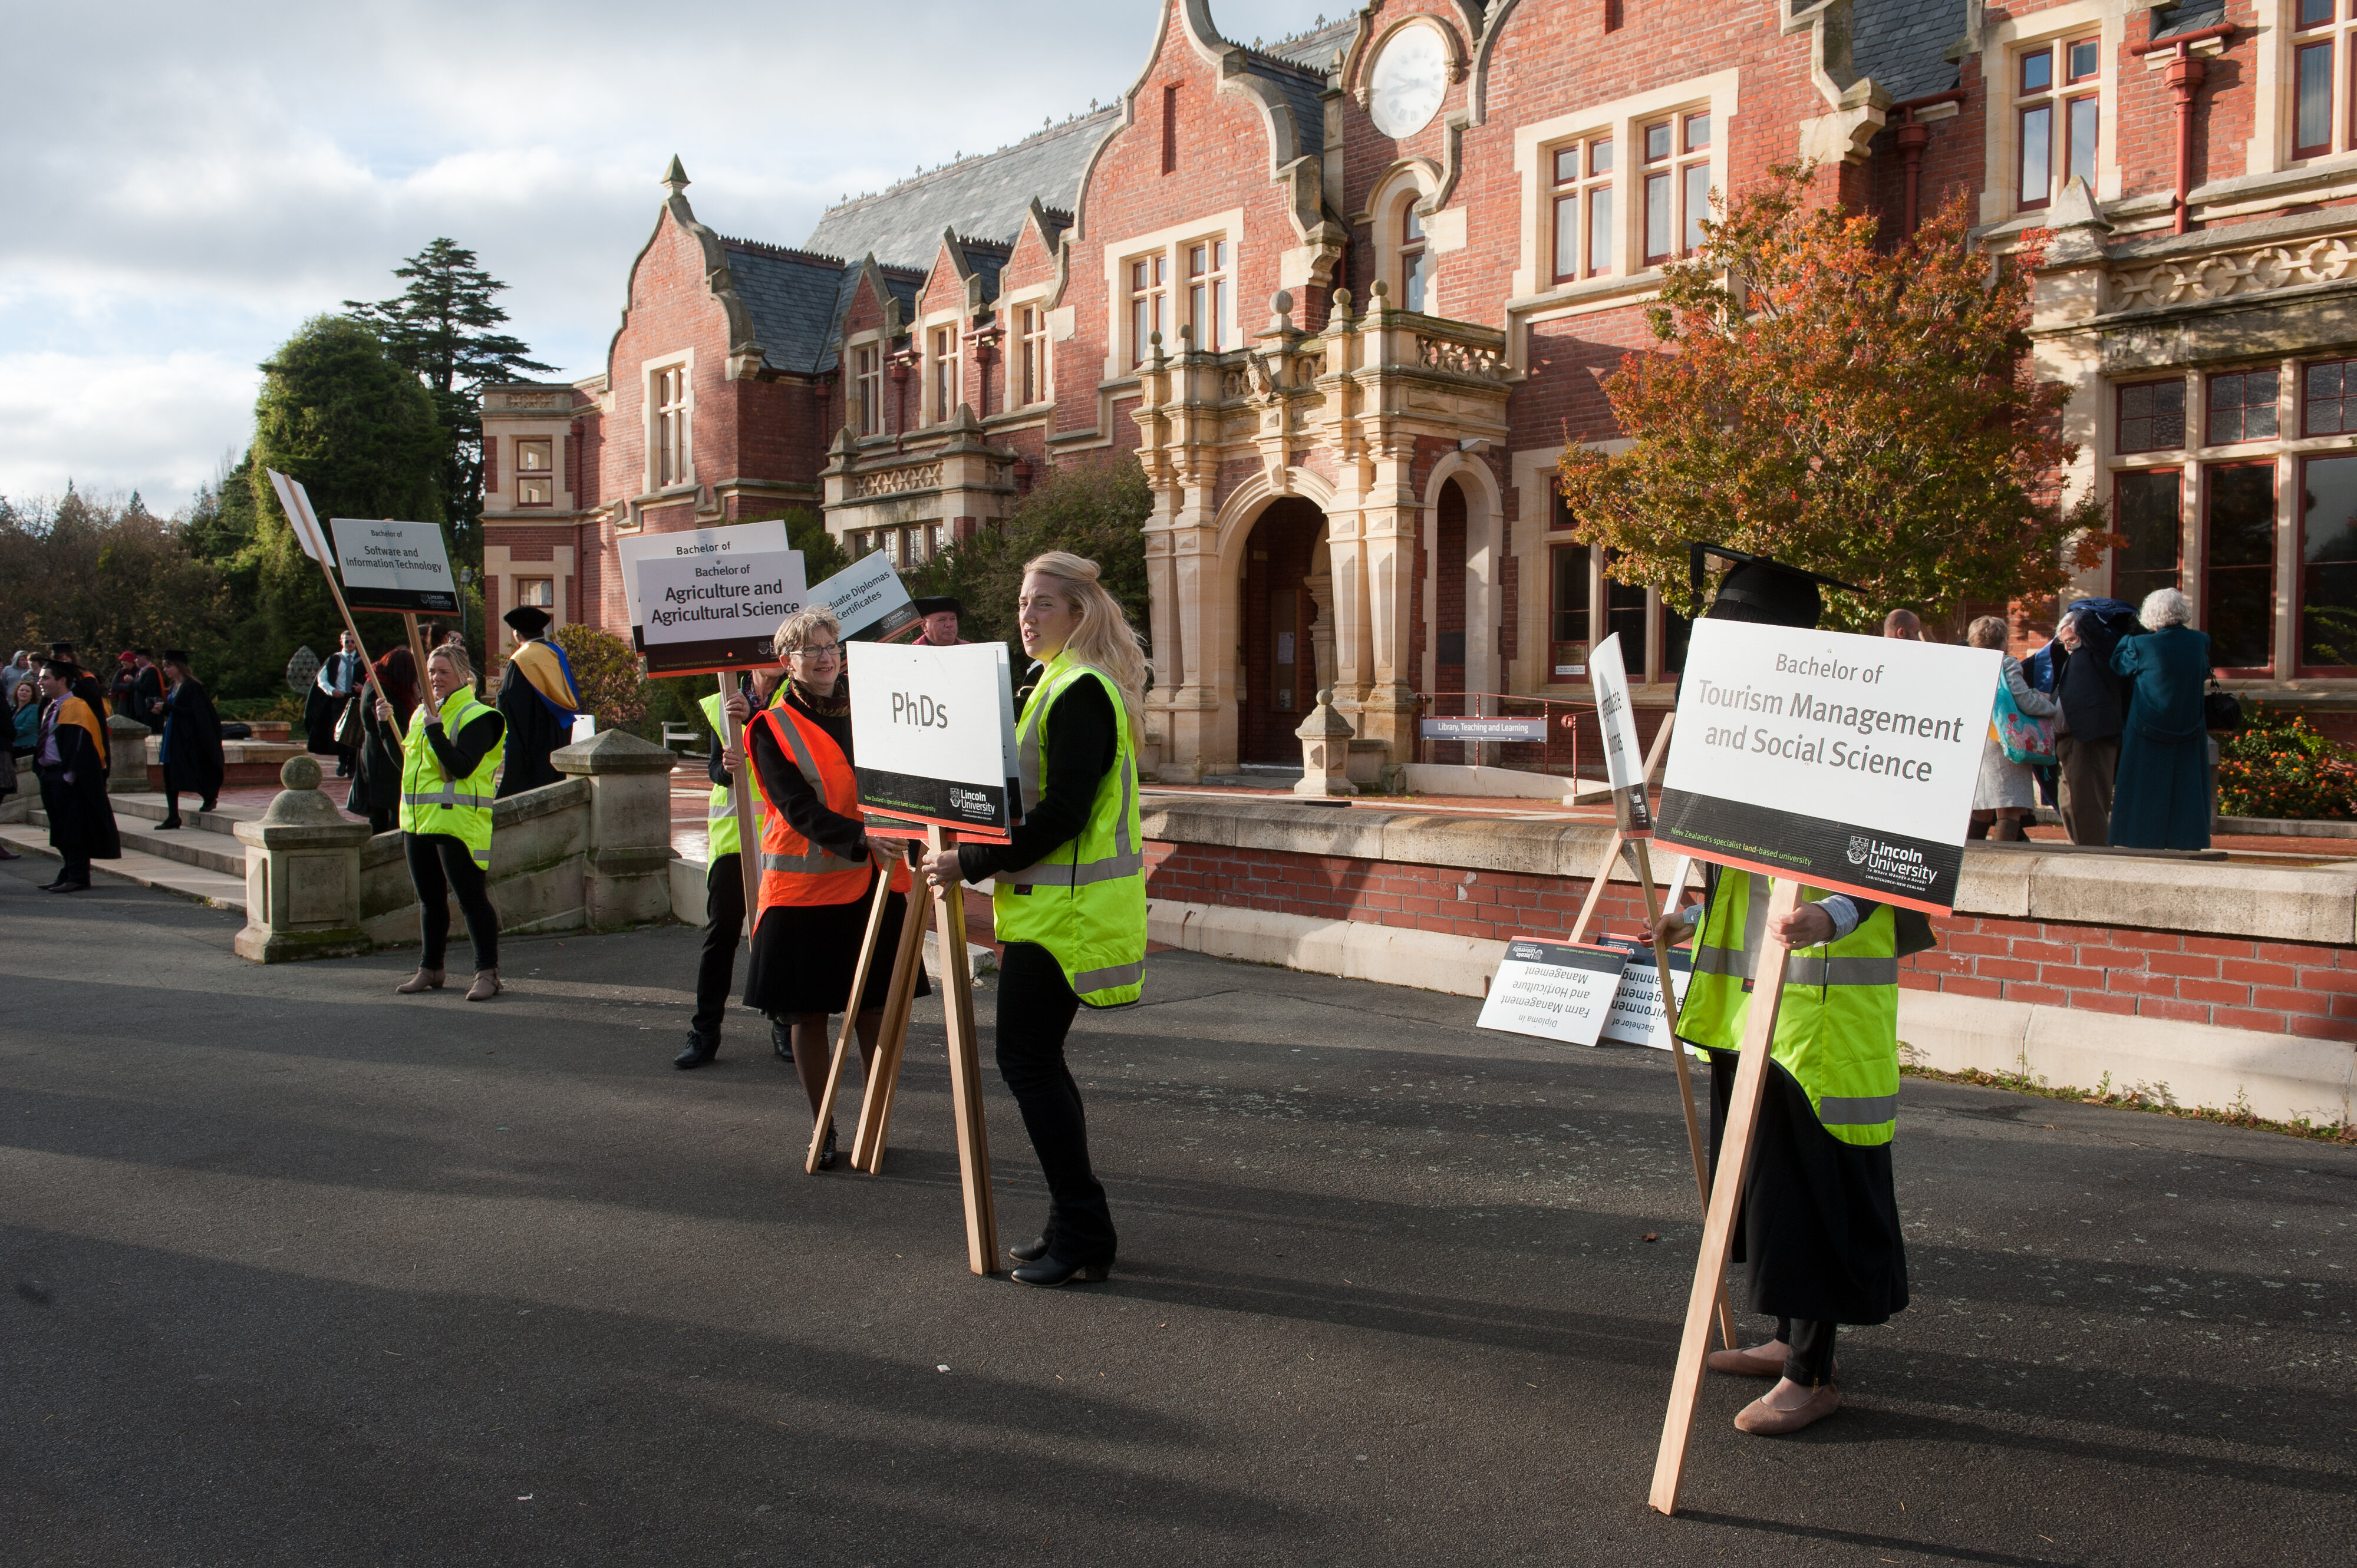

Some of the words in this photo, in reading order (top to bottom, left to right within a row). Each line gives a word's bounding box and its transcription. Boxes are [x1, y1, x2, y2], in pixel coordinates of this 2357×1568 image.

[365, 546, 401, 556] Software
[404, 548, 418, 557] and
[676, 543, 718, 556] Bachelor
[721, 541, 731, 550] of
[346, 557, 394, 568] Information
[395, 559, 441, 573] Technology
[695, 566, 739, 577] Bachelor
[740, 565, 750, 574] of
[665, 583, 750, 603] Agriculture
[754, 579, 783, 595] and
[851, 572, 890, 597] Diplomas
[836, 590, 882, 620] Certificates
[651, 603, 740, 626] Agricultural
[742, 602, 800, 617] Science
[888, 610, 904, 621] Lincoln
[1775, 653, 1858, 681] Bachelor
[1862, 664, 1884, 684] of
[892, 692, 948, 729] PhDs
[1699, 679, 1783, 715] Tourism
[1789, 692, 1964, 743] Management
[1438, 722, 1459, 732] Library,
[1460, 722, 1487, 733] Teaching
[1488, 723, 1499, 731] and
[1501, 724, 1528, 734] Learning
[1705, 724, 1748, 750] and
[1751, 728, 1825, 764] Social
[1829, 741, 1932, 782] Science
[961, 789, 986, 801] Lincoln
[961, 798, 995, 815] University
[1671, 827, 1684, 837] New
[1684, 830, 1712, 843] Zealand's
[1713, 838, 1742, 850] specialist
[1742, 843, 1778, 858] land-based
[1779, 852, 1812, 867] university
[1871, 840, 1923, 864] Lincoln
[1868, 853, 1938, 884] University
[1512, 946, 1535, 954] University
[1525, 966, 1588, 984] Management
[1512, 981, 1568, 998] Horticulture
[1570, 988, 1590, 999] and
[1501, 995, 1563, 1013] Management
[1565, 1005, 1590, 1018] Farm
[1527, 1016, 1558, 1028] Diploma
[1611, 1018, 1620, 1026] of
[1621, 1019, 1654, 1033] Bachelor
